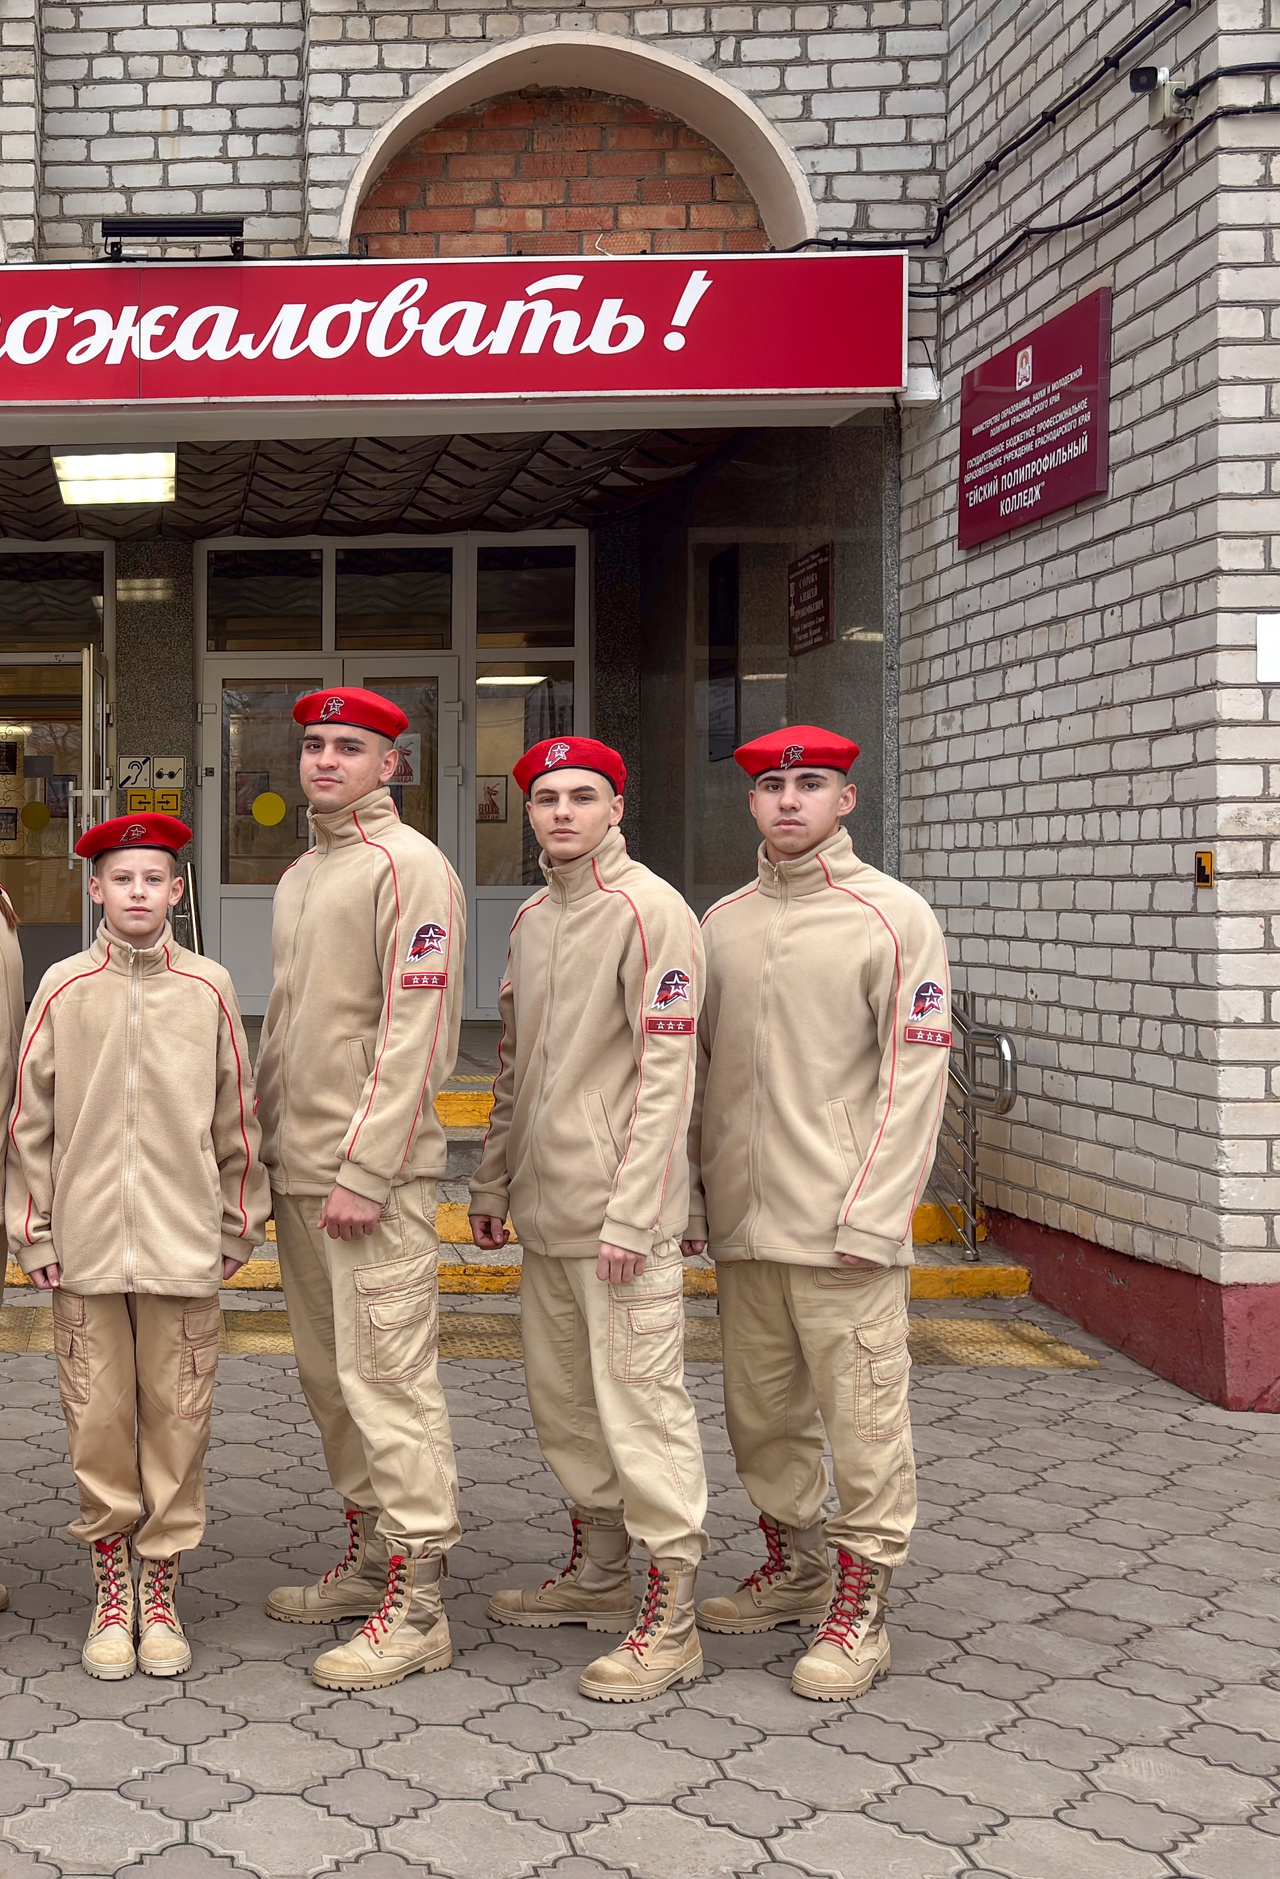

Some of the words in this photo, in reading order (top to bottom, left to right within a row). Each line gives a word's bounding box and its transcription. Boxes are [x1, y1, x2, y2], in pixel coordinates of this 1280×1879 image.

[967, 442, 1004, 469] ГОСУДАРСТВЕННОЕ
[1005, 429, 1035, 452] БЮДЖЕТНОЕ
[1036, 398, 1088, 434] ПРОФЕССИОНАЛЬНОЕ
[972, 414, 1000, 436] МИНИСТЕРСТВО
[1032, 388, 1046, 402] НАУКИ
[1051, 366, 1083, 393] МОЛОДЕЖНОЙ
[990, 421, 1010, 437] ПОЛИТИКИ
[1010, 402, 1048, 429] КРАСНОДАРСКОГО
[1049, 393, 1060, 408] КРАЯ
[964, 459, 1002, 484] ОБРАЗОВАТЕЛЬНОЕ
[1003, 442, 1033, 464] УЧРЕЖДЕНИЕ
[1034, 420, 1077, 451] КРАСНОДАРСКОГО
[1078, 411, 1091, 429] КРАЯ
[966, 475, 999, 507] "ЕЙСКИЙ
[1001, 431, 1088, 489] ПОЛИПРОФИЛЬНЫЙ
[1000, 481, 1045, 516] КОЛЛЕДЖ"
